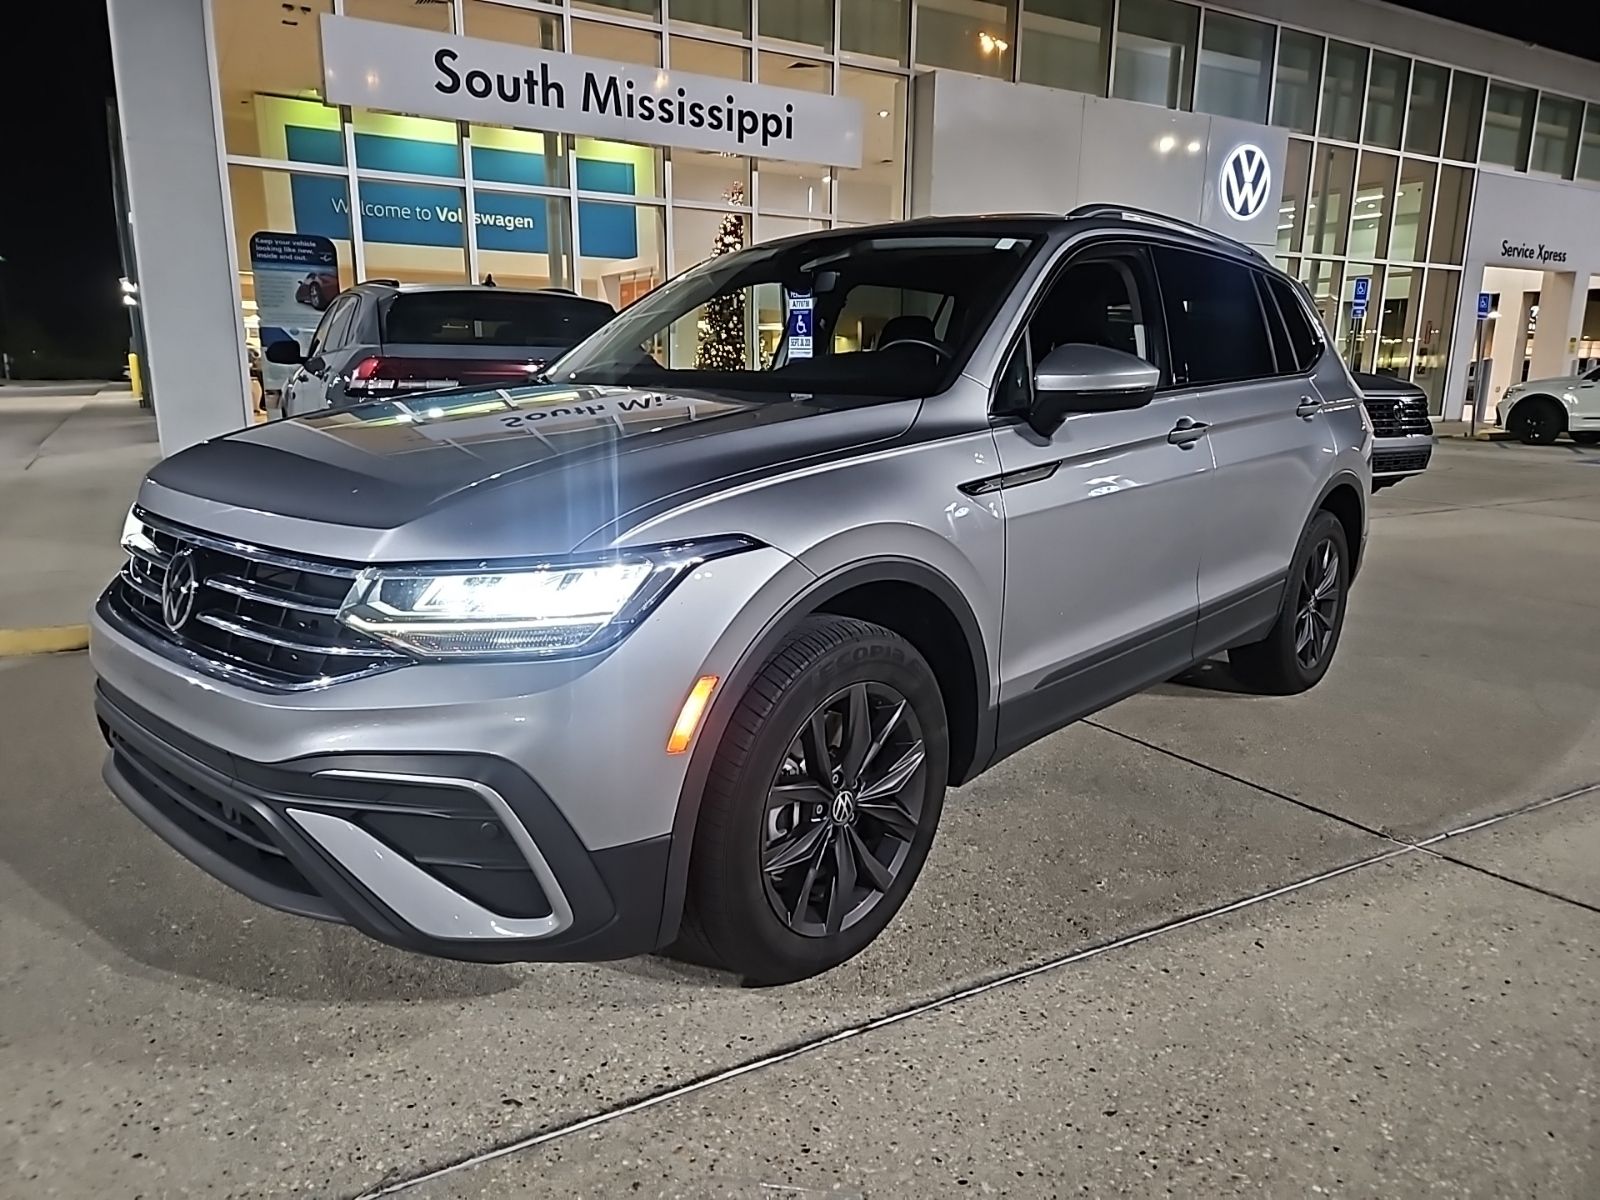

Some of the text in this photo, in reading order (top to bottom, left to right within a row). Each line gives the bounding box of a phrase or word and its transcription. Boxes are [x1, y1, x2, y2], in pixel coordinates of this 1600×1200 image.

[433, 48, 794, 147] South Mississippi
[1221, 145, 1271, 221] VW
[331, 197, 534, 230] Wlcome to Volswagen
[255, 236, 272, 245] Keep
[292, 240, 317, 248] vehicle
[256, 244, 282, 253] looking
[1501, 239, 1567, 264] Service Xpress
